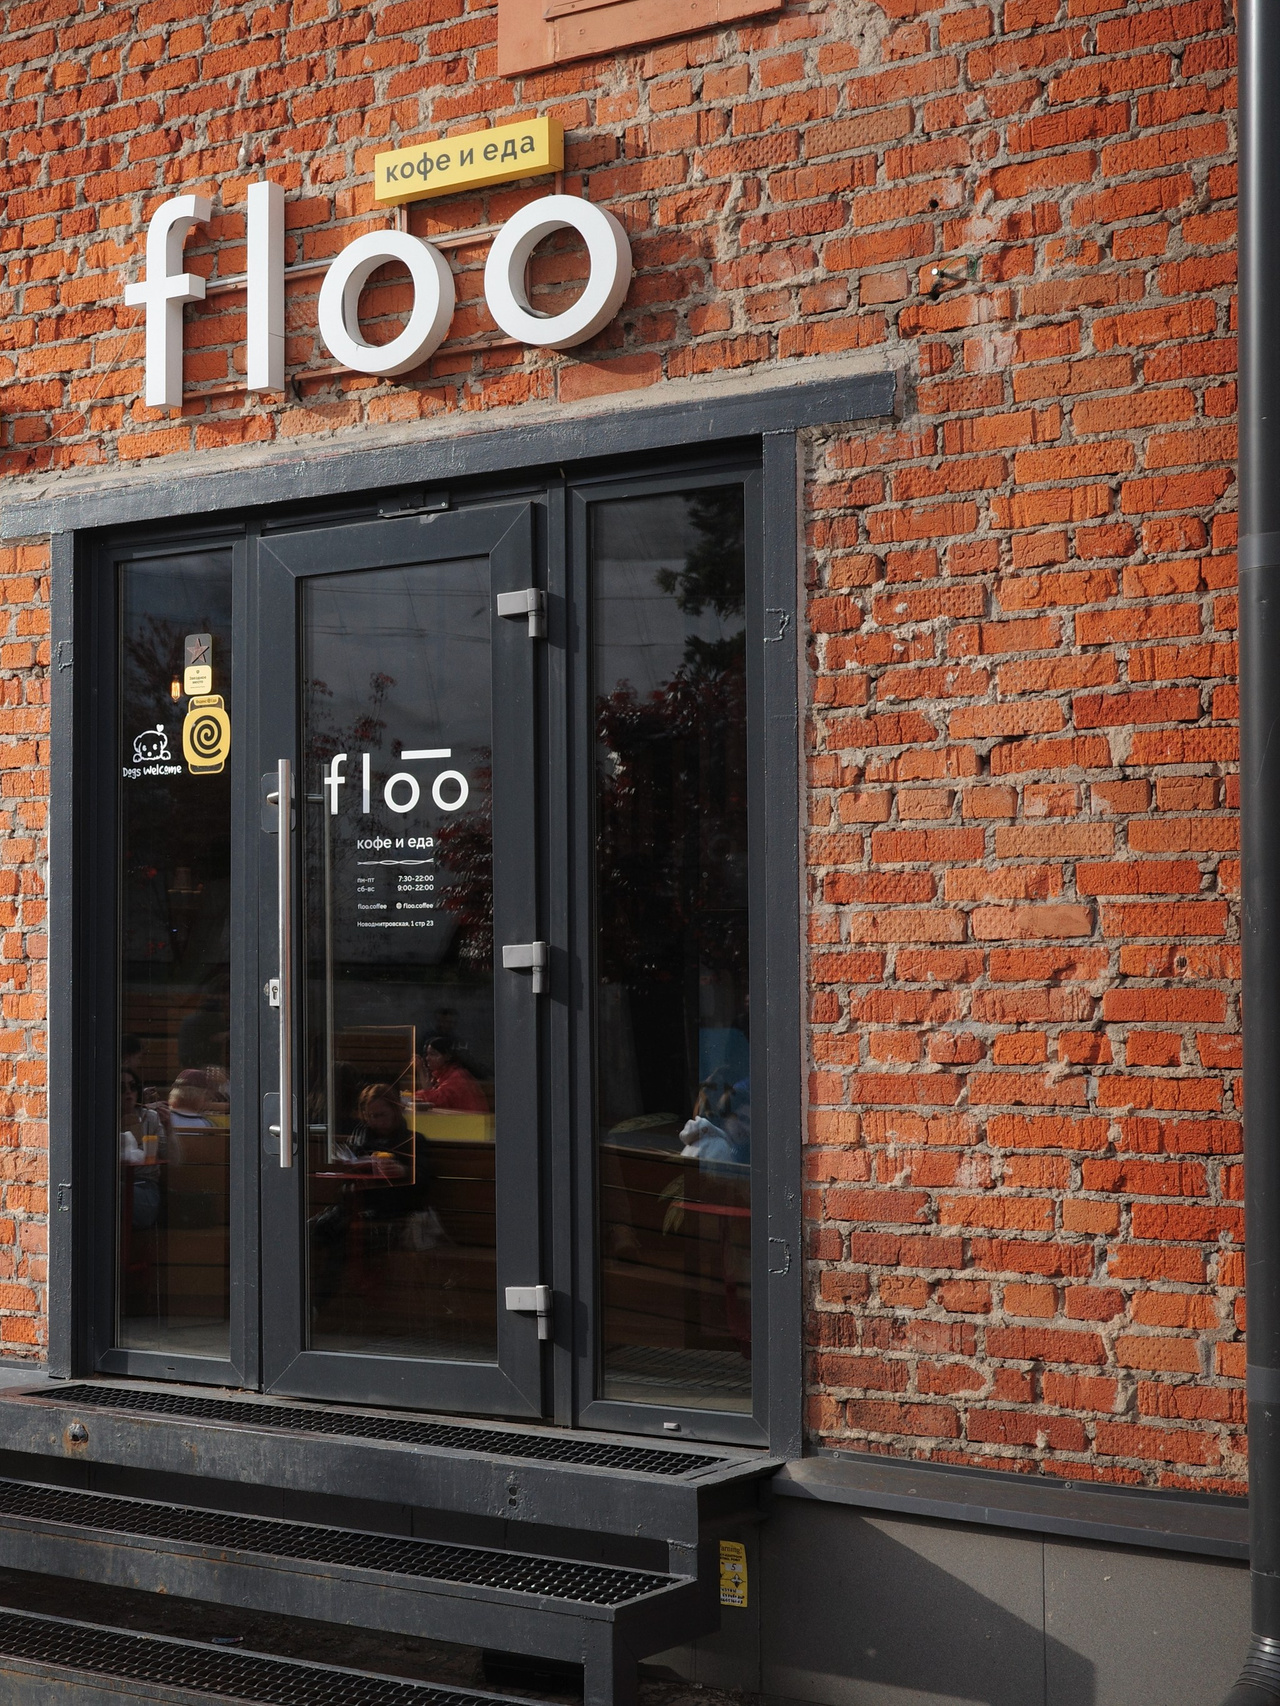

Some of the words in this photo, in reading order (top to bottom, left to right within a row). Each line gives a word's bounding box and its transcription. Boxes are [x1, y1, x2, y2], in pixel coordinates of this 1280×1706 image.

[386, 152, 451, 183] кофе
[459, 148, 474, 167] и
[483, 134, 535, 163] еда
[124, 180, 631, 412] floo
[123, 767, 142, 779] Dogs
[143, 764, 183, 776] Welcome
[324, 749, 469, 815] floo
[357, 835, 392, 851] кофе
[395, 838, 404, 848] и
[407, 836, 434, 850] еда
